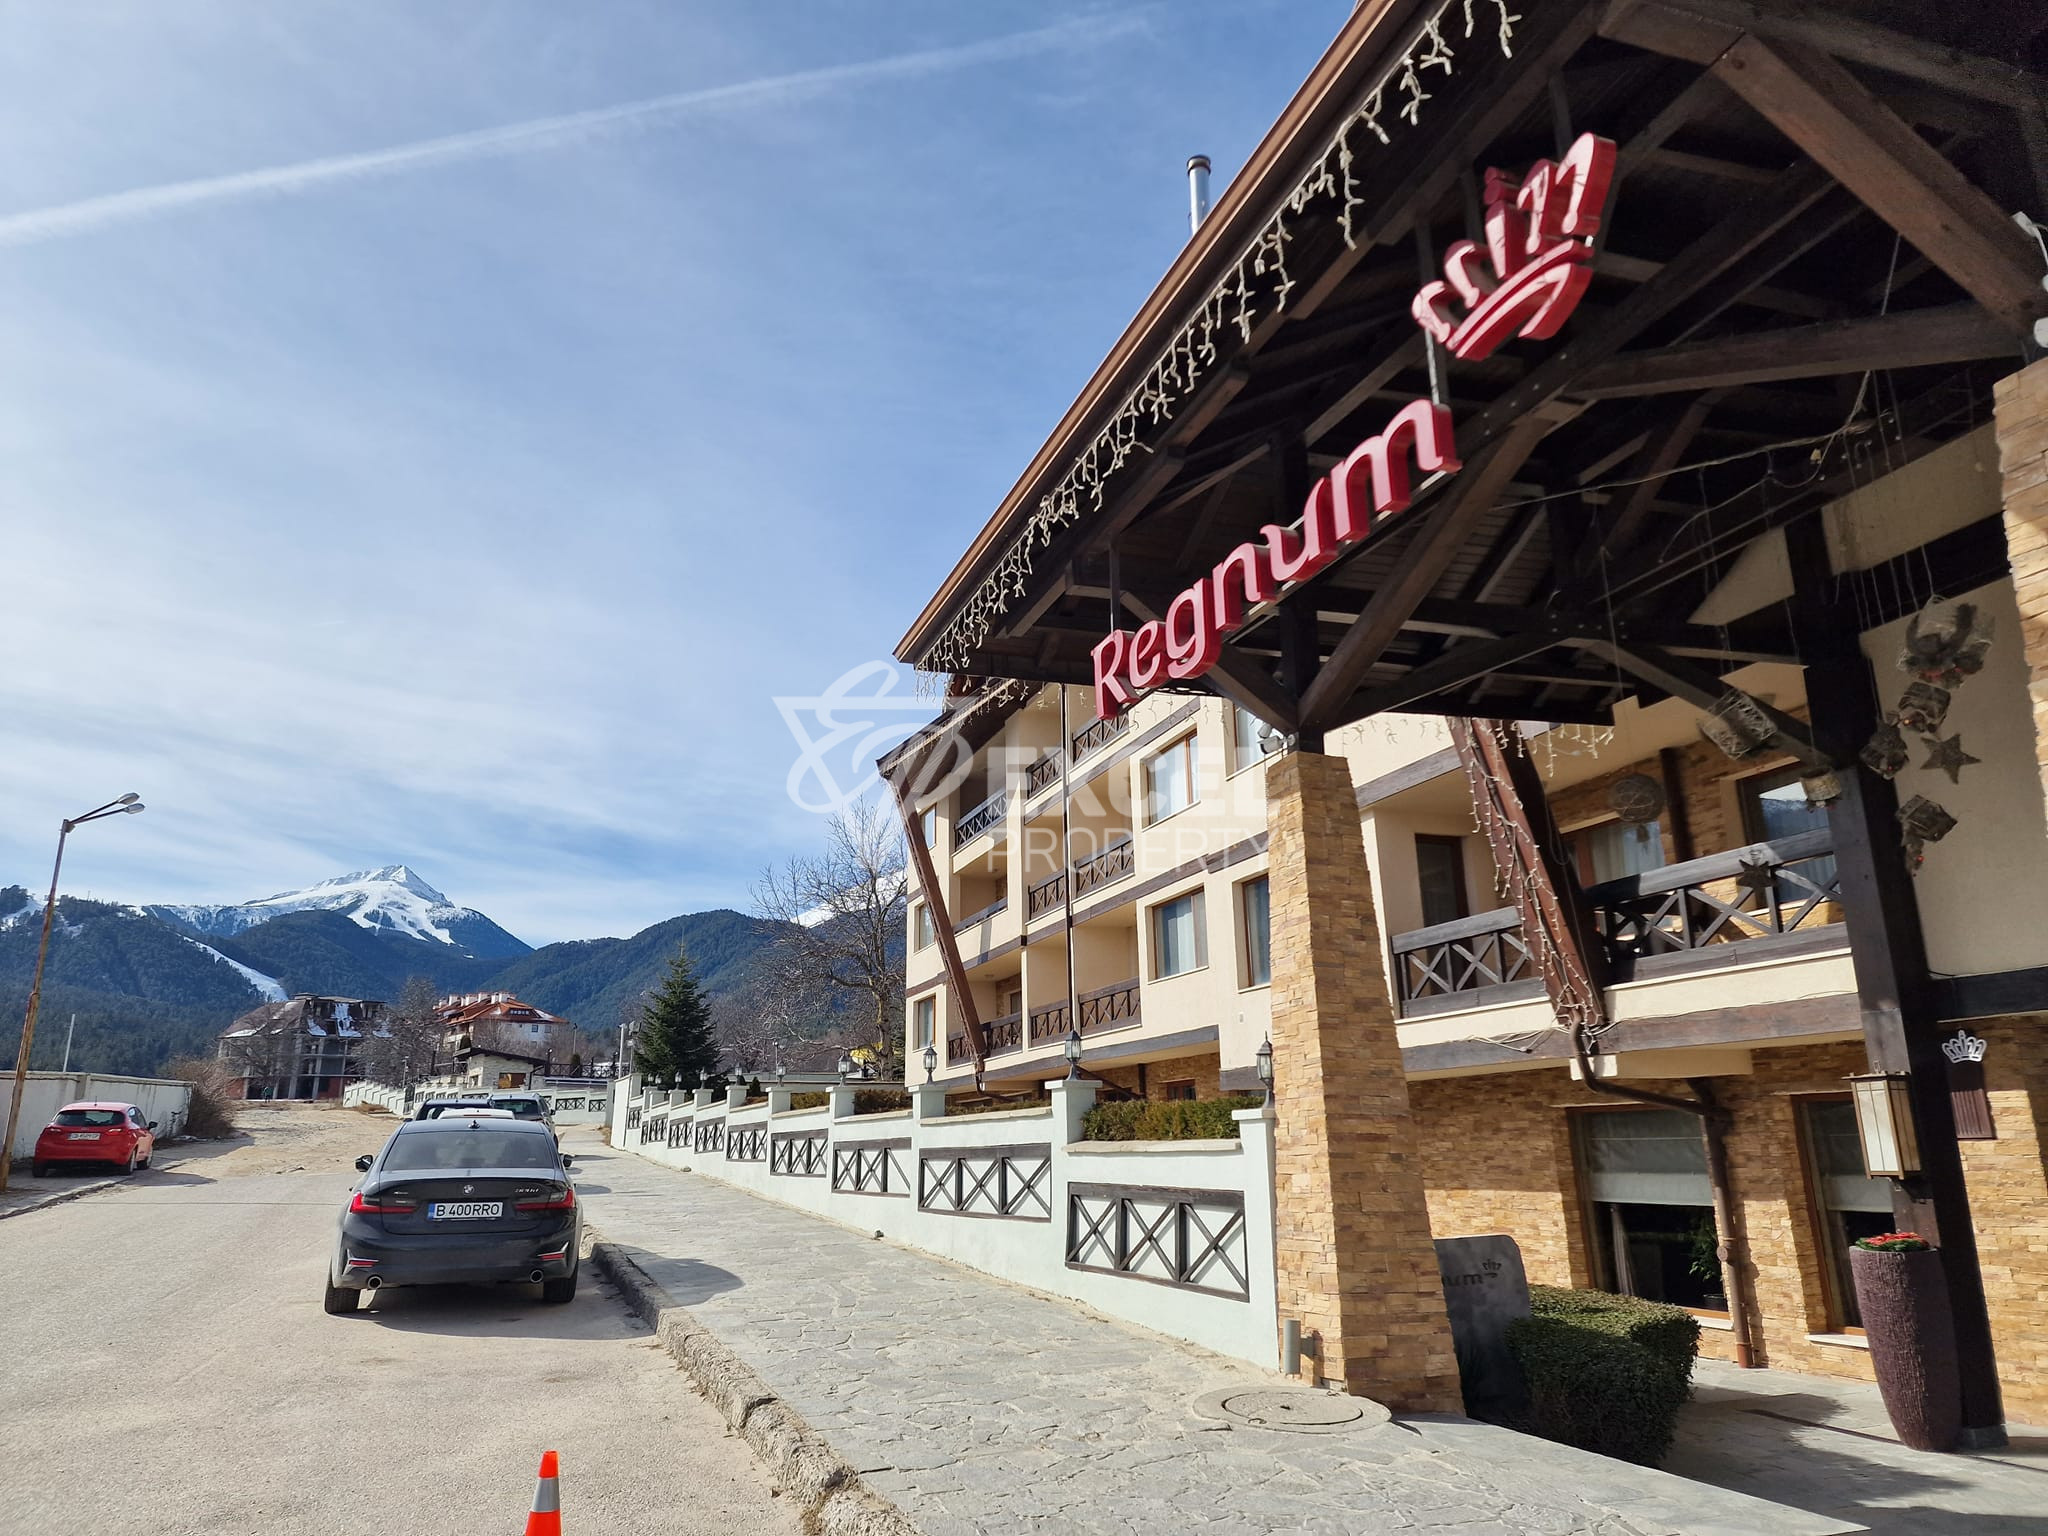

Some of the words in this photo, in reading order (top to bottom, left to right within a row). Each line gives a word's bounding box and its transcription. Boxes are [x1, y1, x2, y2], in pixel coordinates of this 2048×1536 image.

[1091, 399, 1458, 720] Regnum
[436, 1204, 446, 1217] B
[449, 1203, 500, 1216] 400RRO
